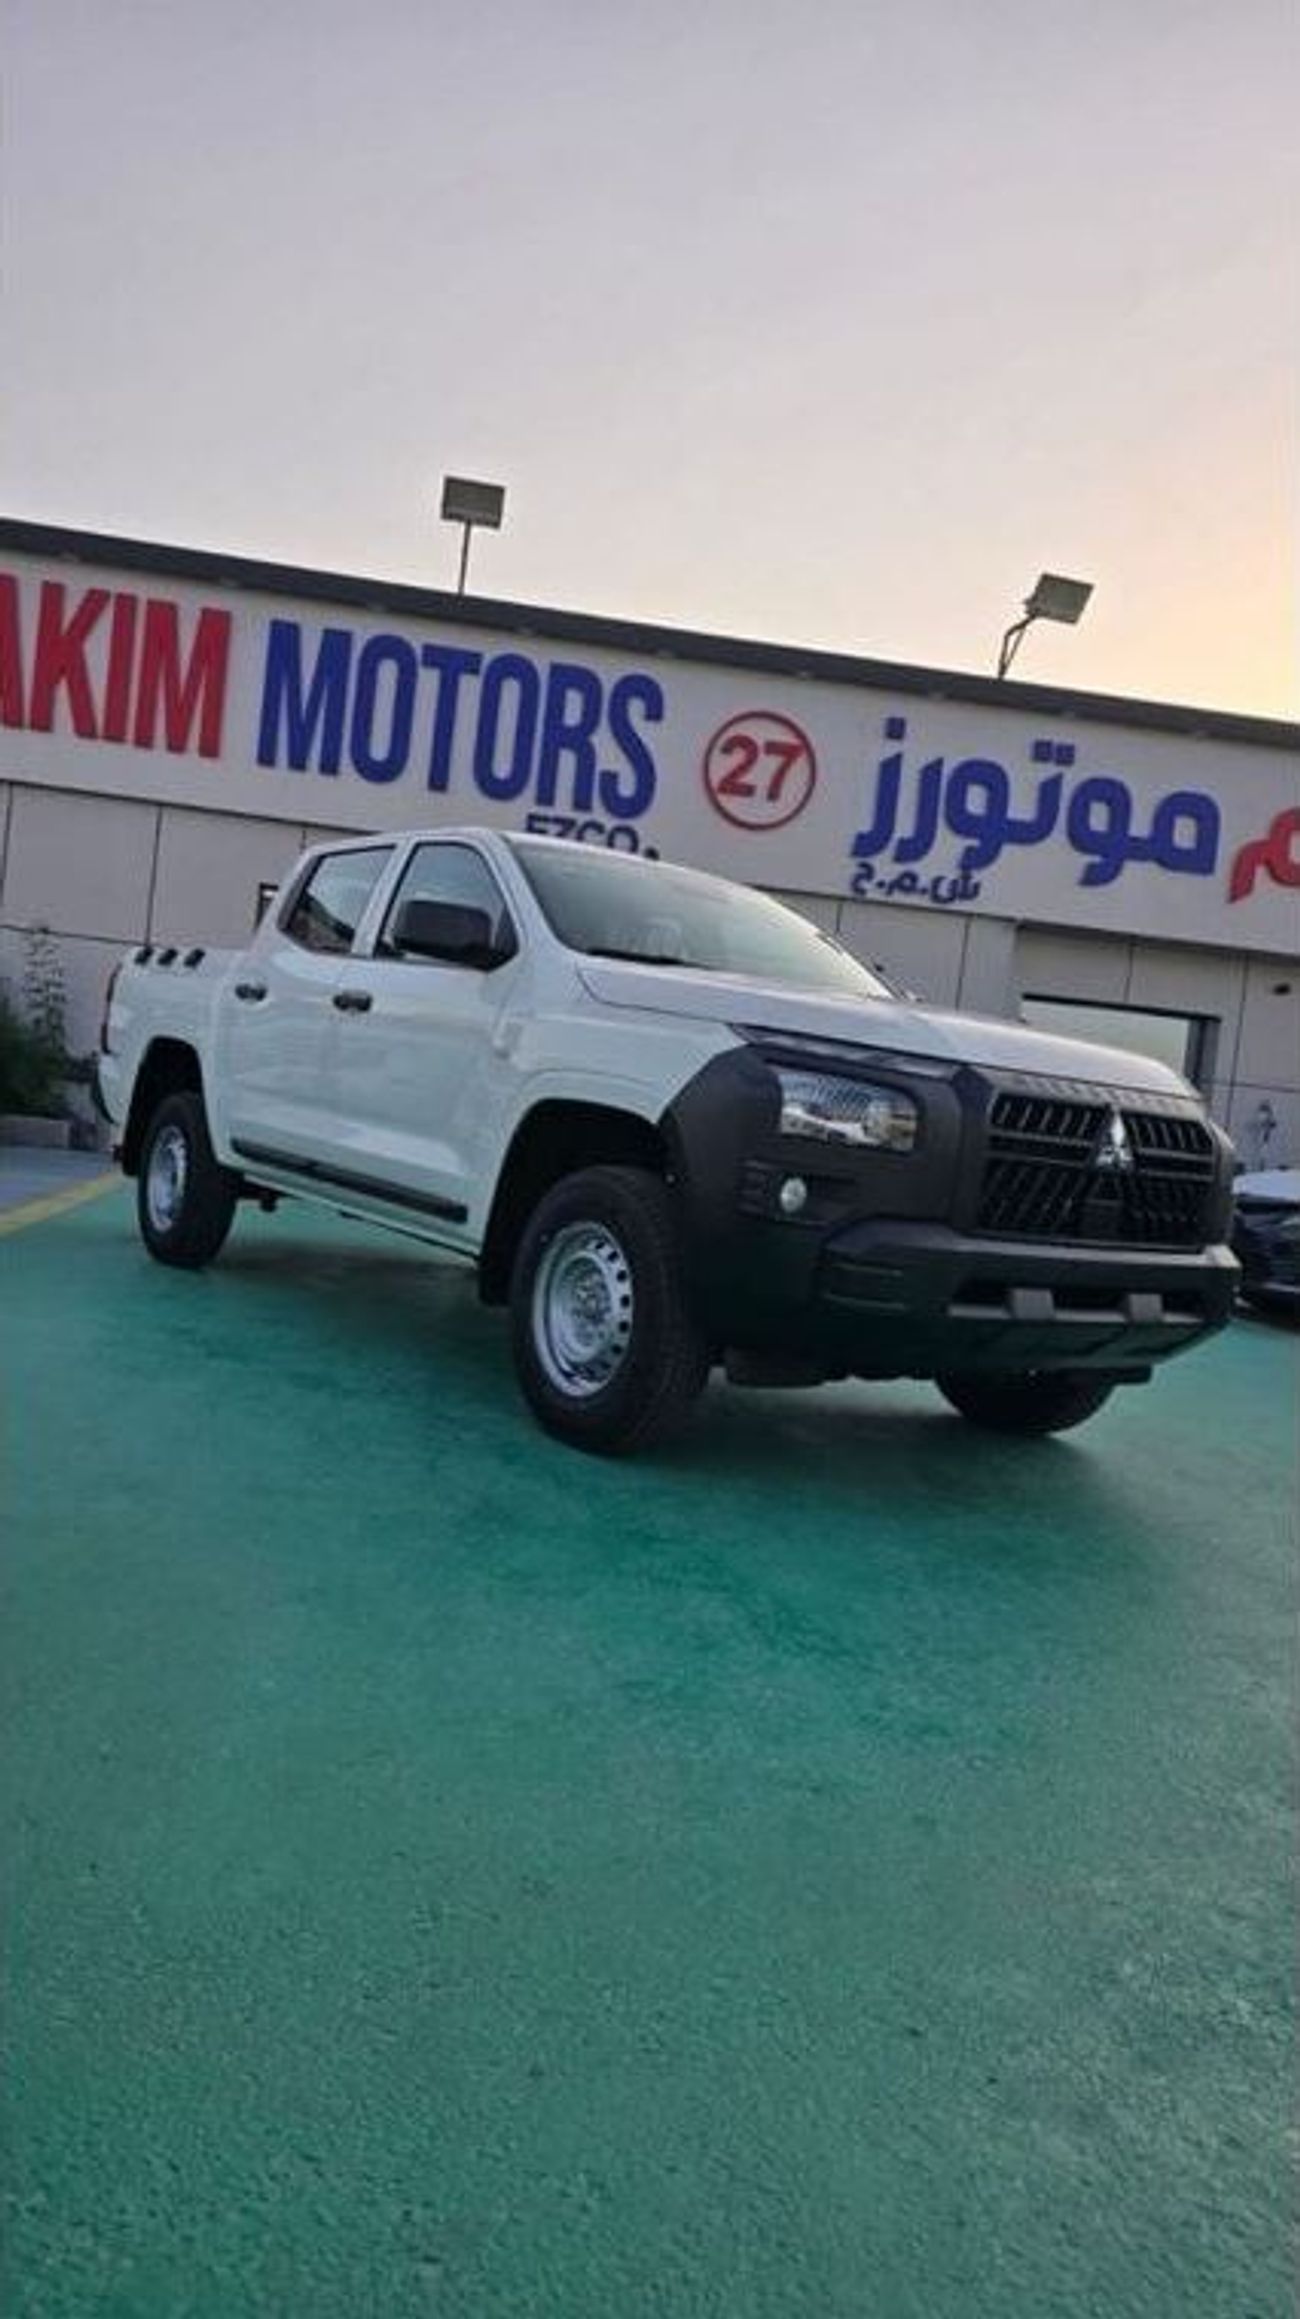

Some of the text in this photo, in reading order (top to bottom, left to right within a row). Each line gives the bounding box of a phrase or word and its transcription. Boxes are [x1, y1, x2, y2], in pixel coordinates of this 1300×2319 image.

[256, 618, 665, 820] MOTORS
[716, 734, 803, 802] 27
[850, 717, 1221, 887] موتورز
